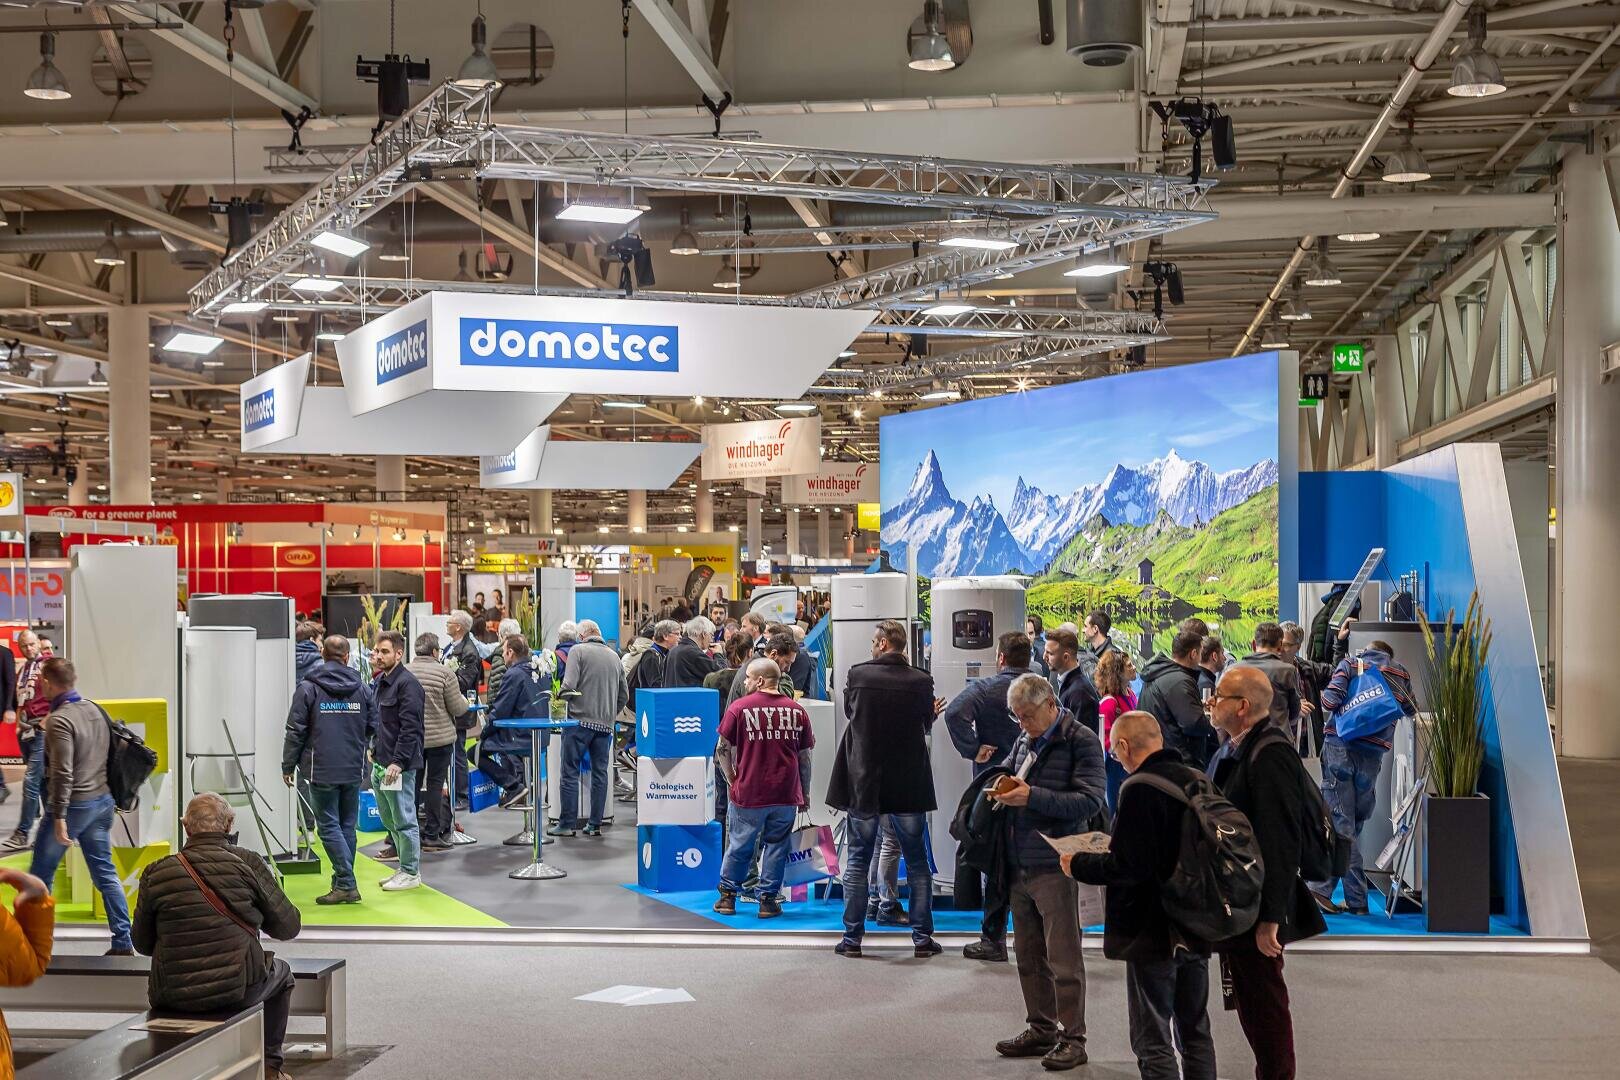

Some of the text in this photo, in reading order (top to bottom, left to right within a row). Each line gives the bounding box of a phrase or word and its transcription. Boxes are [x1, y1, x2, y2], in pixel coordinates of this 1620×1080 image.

[469, 321, 670, 363] domotec
[377, 330, 426, 376] domotec
[244, 392, 274, 426] domotec
[726, 439, 785, 462] windhager
[807, 475, 861, 494] windhager
[82, 510, 99, 519] for
[107, 511, 144, 520] greener
[146, 509, 177, 521] planet
[286, 553, 313, 561] GRAF
[742, 707, 803, 732] NYHC
[649, 781, 694, 791] Ökologisch
[645, 792, 698, 800] Warmwasser
[789, 847, 812, 863] BWT
